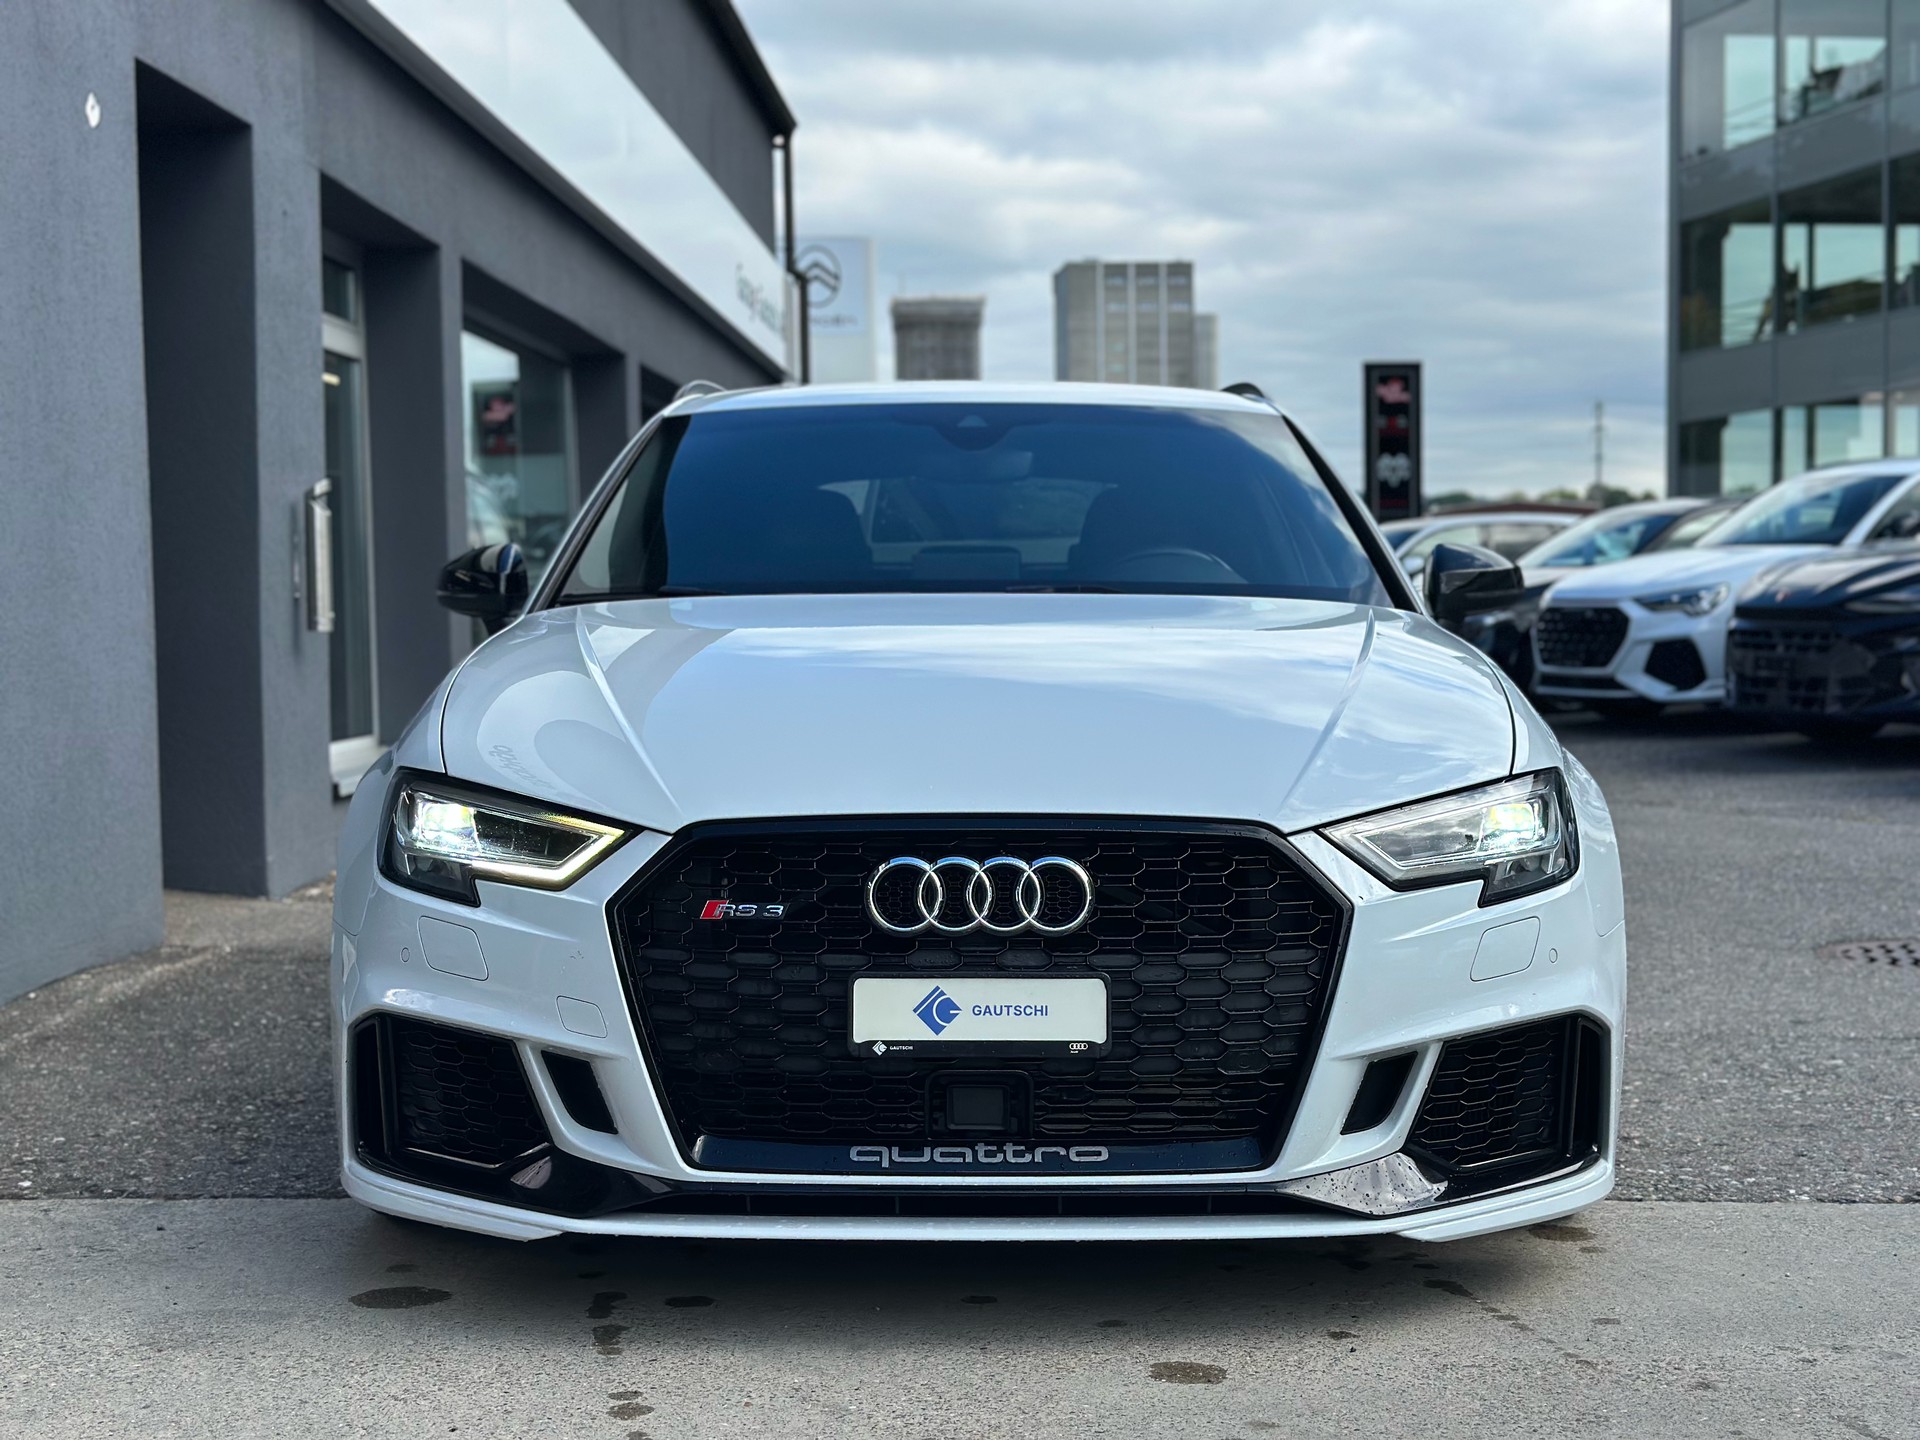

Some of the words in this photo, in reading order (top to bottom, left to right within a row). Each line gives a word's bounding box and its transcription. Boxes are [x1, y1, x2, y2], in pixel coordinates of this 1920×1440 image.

[713, 904, 758, 917] RS
[763, 905, 784, 917] 3
[972, 1004, 1049, 1017] GAUTSCHI
[849, 1142, 1109, 1168] quattro
